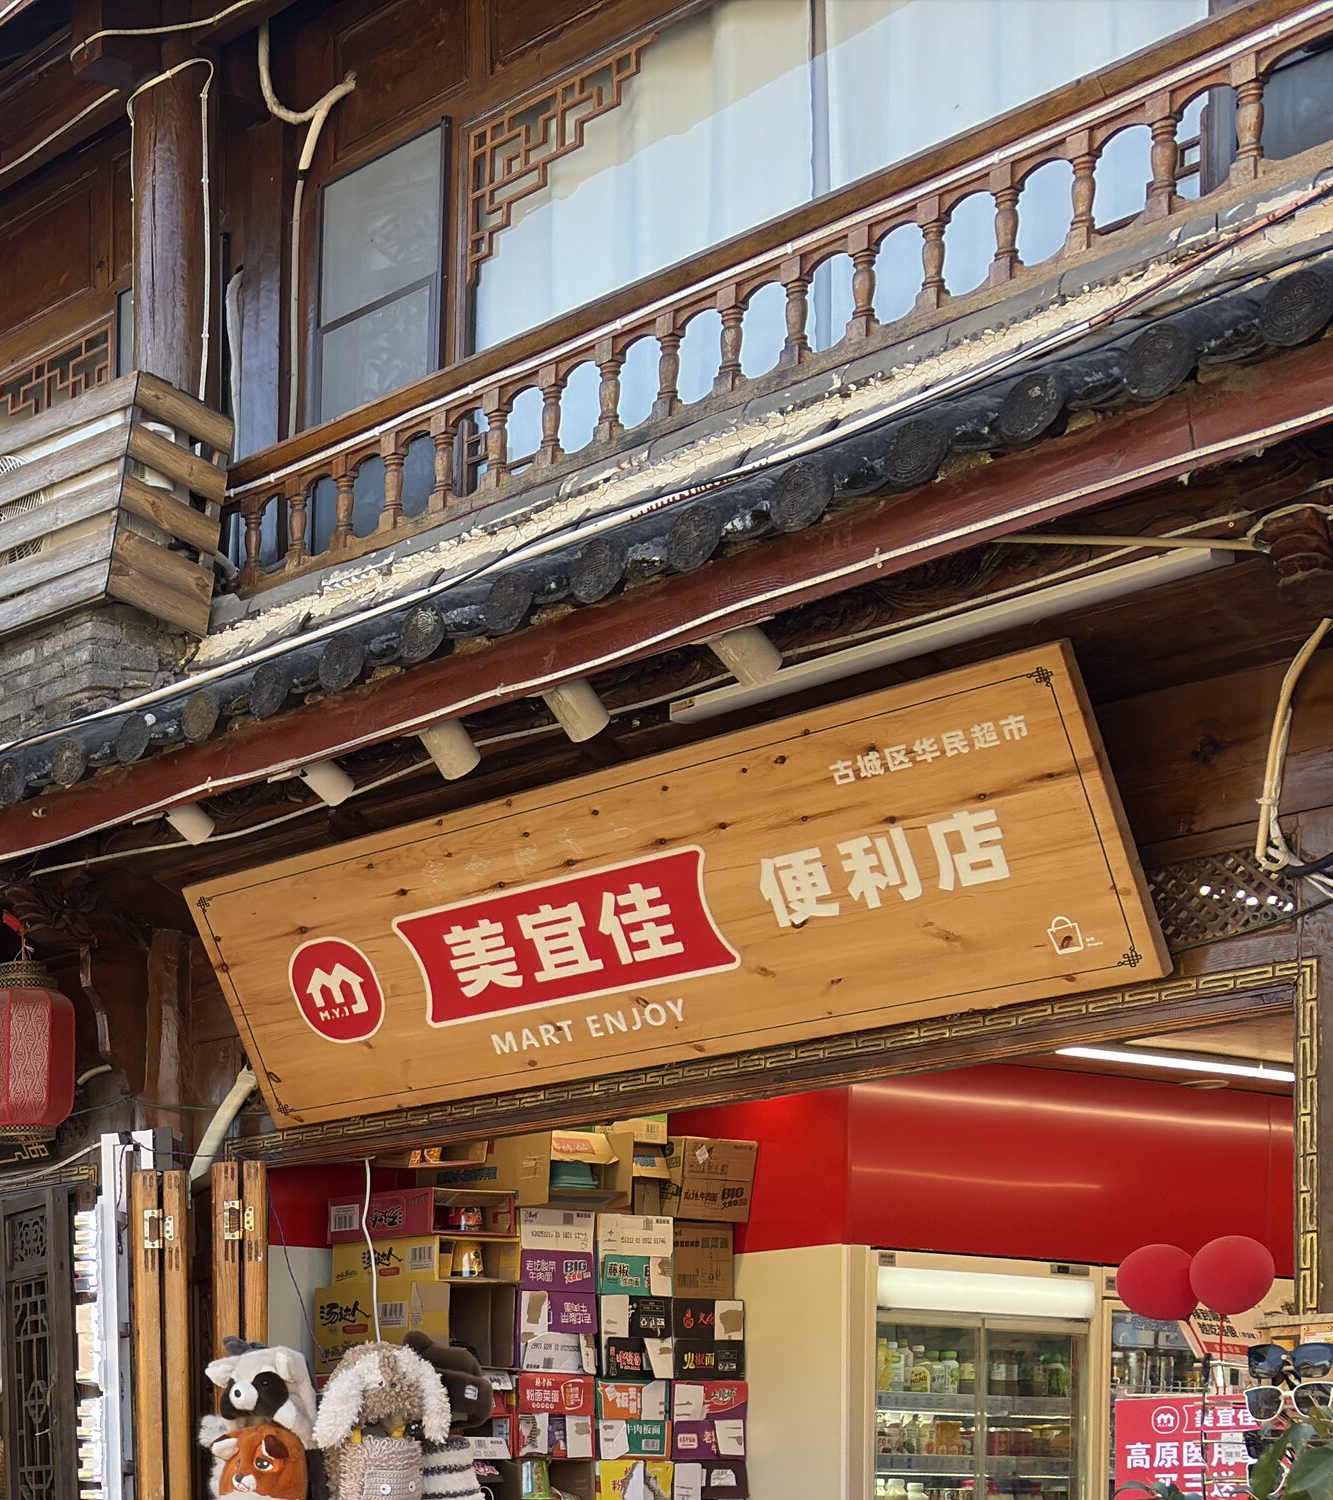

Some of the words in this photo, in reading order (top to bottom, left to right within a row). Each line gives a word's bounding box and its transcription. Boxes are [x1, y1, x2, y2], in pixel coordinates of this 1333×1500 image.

[827, 713, 1029, 786] 古城区华民超市
[758, 807, 1012, 928] 便利店
[442, 882, 685, 998] 美宜佳
[491, 1020, 575, 1056] MART
[588, 998, 686, 1039] ENJOY
[528, 1271, 553, 1283] 牛肉面
[564, 1259, 588, 1273] BIG
[607, 1262, 631, 1278] 藤椒
[319, 1300, 371, 1327] 汤达人
[682, 1351, 716, 1370] 鬼椒面
[1194, 1408, 1258, 1428] 美宜佳
